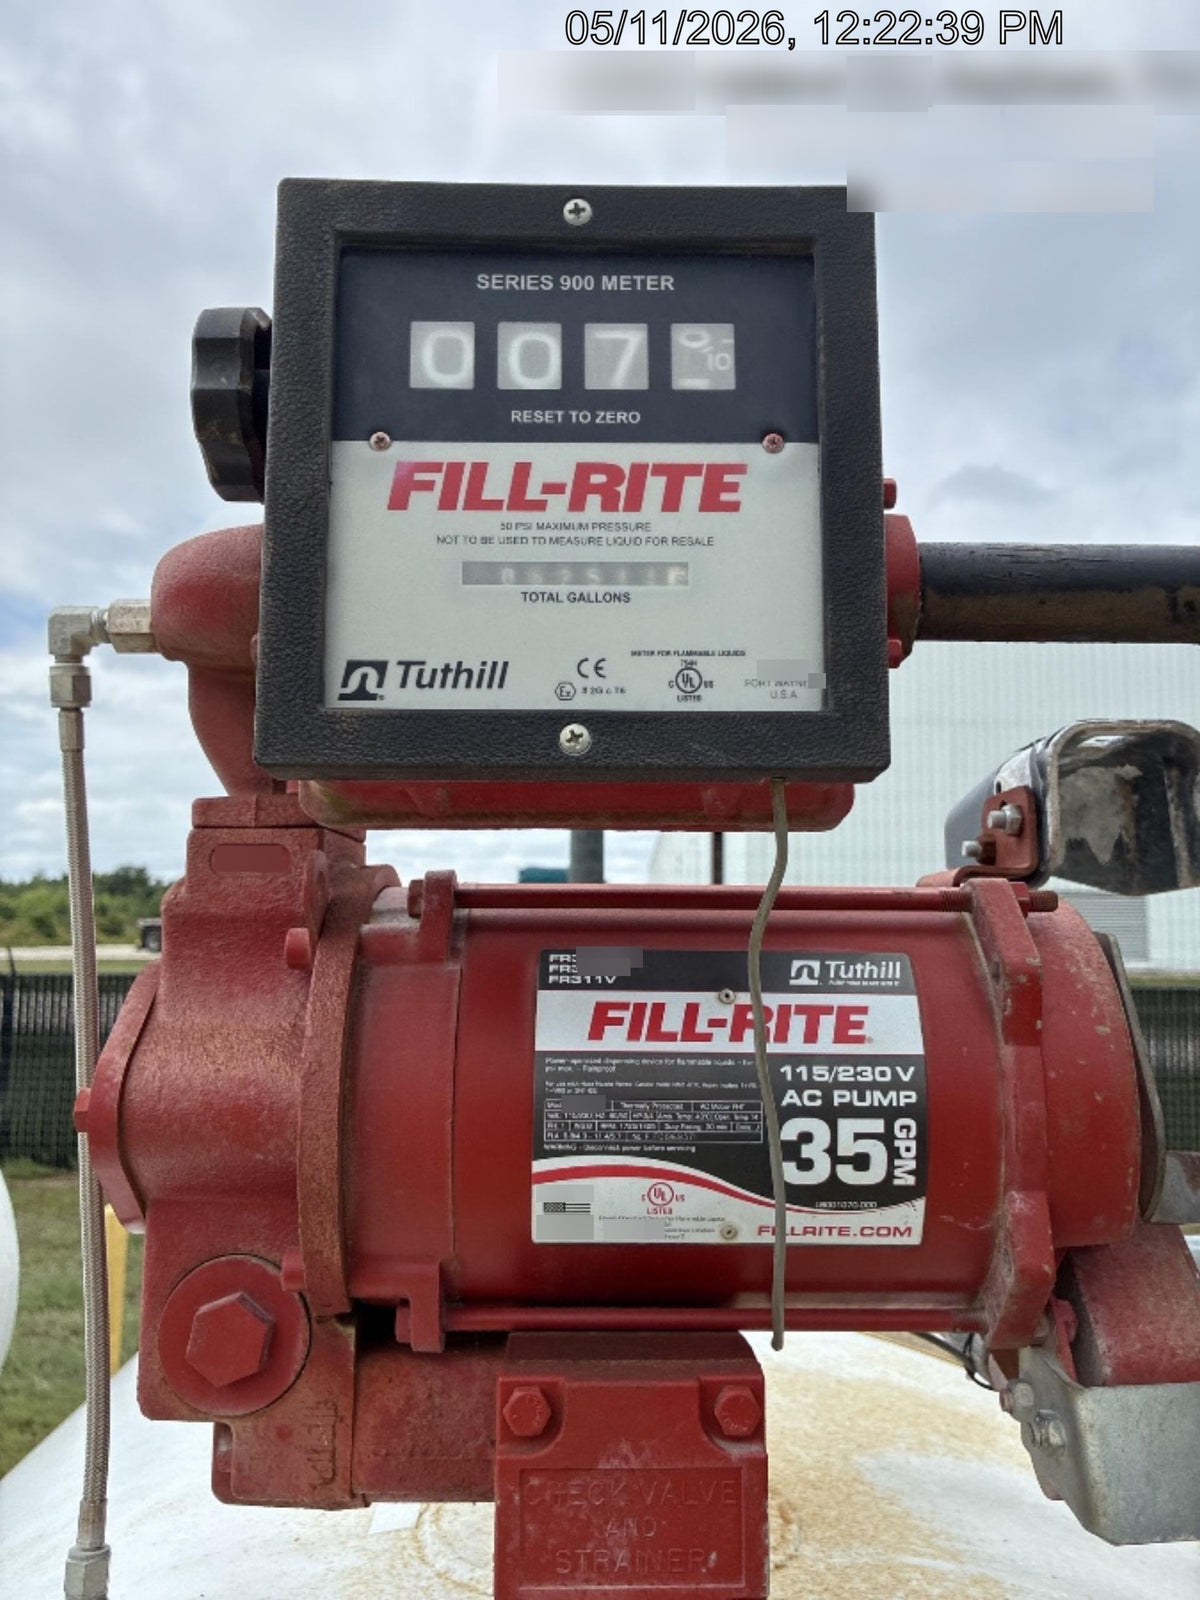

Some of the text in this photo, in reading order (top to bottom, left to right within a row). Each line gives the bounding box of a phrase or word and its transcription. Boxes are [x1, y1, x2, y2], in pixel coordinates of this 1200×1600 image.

[476, 274, 675, 292] SERIES 900 METER
[510, 410, 641, 425] RESET TO ZERO
[387, 462, 748, 513] FILL-RITE
[515, 522, 533, 532] PSI
[536, 522, 590, 532] MAXIMUM
[591, 523, 652, 532] PRESSURE
[436, 535, 715, 547] NOT TO BE USED TO MEASURE LIQUID FOR RESALE
[520, 591, 632, 604] TOTAL GALLONS
[396, 660, 510, 690] Tuthill
[825, 961, 901, 979] Tuthill
[548, 975, 616, 984] FR311V
[587, 1001, 869, 1044] FILL-RITE
[780, 1066, 916, 1083] 115/230 V
[781, 1089, 918, 1107] AC PUMP
[779, 1117, 888, 1186] 35
[894, 1117, 917, 1186] GPM
[524, 1480, 738, 1505] CHECK VALVE
[605, 1516, 657, 1538] AND
[555, 1549, 705, 1575] STRAINER
